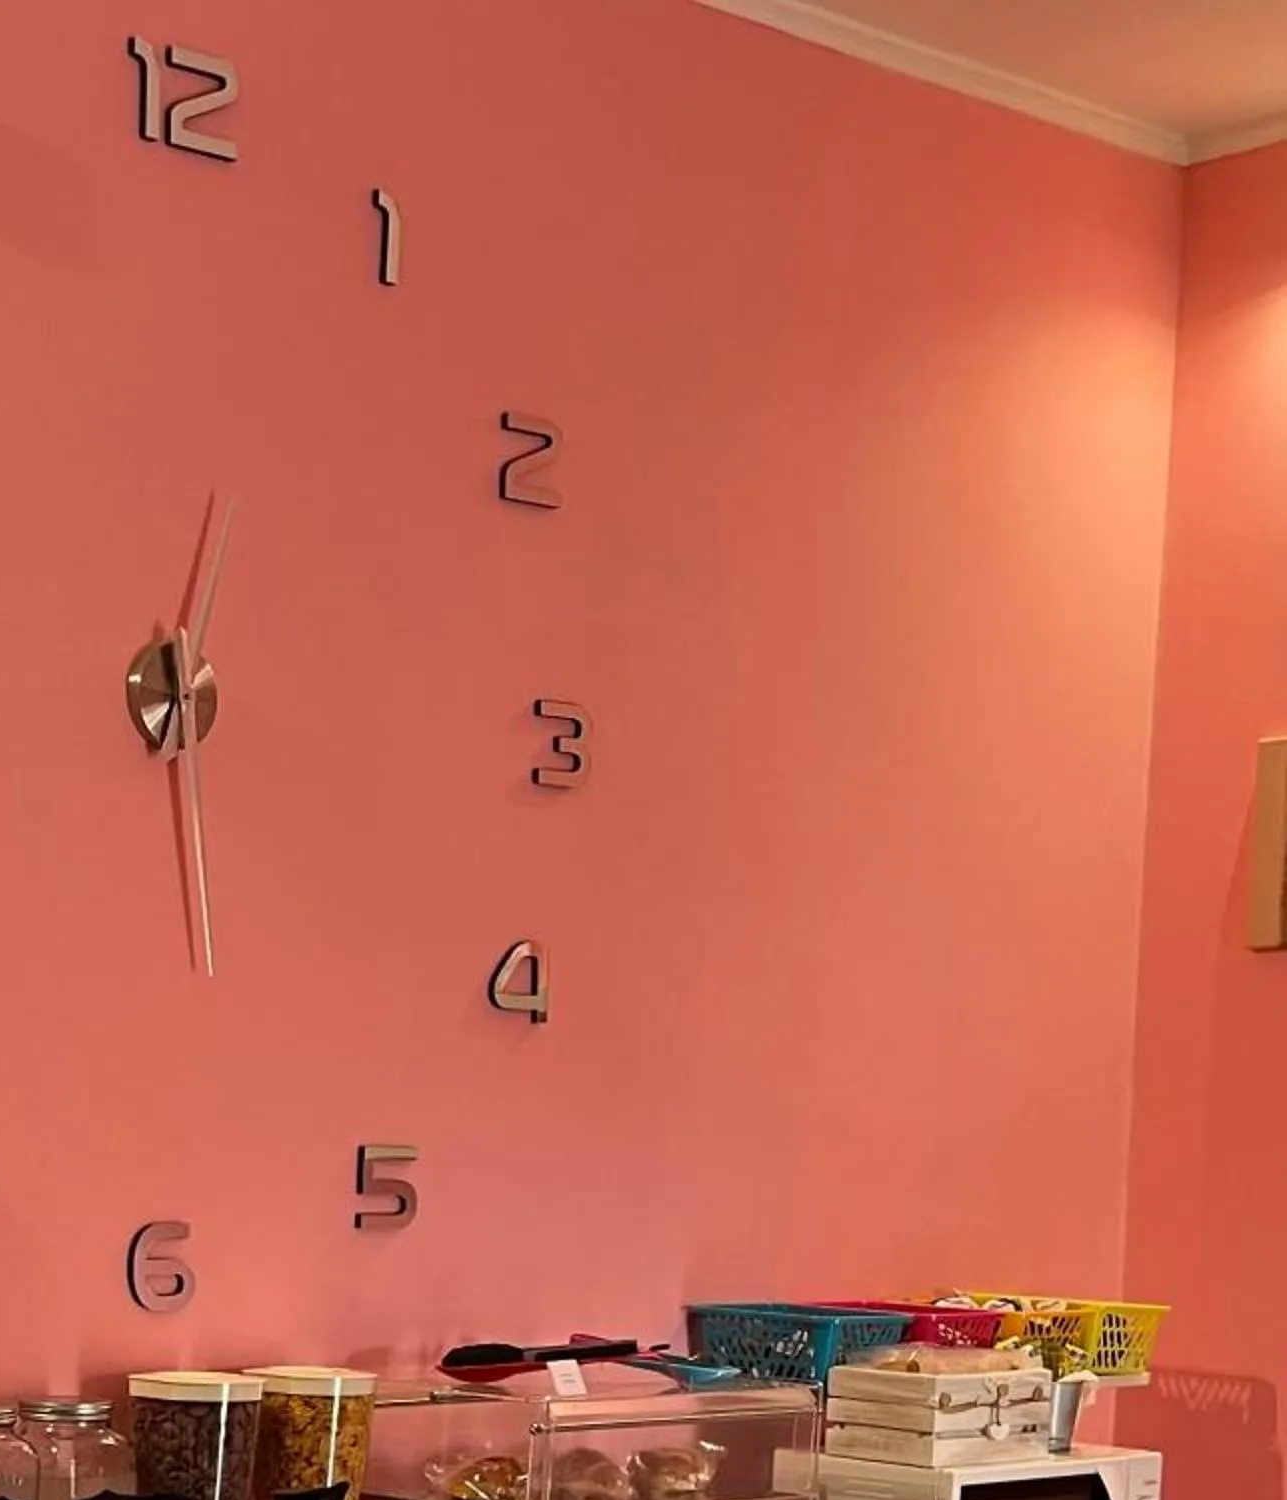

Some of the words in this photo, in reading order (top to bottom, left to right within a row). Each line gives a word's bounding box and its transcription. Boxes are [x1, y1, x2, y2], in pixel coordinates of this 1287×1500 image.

[127, 35, 239, 162] 12
[370, 186, 403, 287] 1
[499, 411, 563, 509] 2
[531, 699, 594, 790] 3
[488, 939, 550, 1025] 4
[353, 1143, 419, 1231] 5
[126, 1220, 197, 1312] 6
